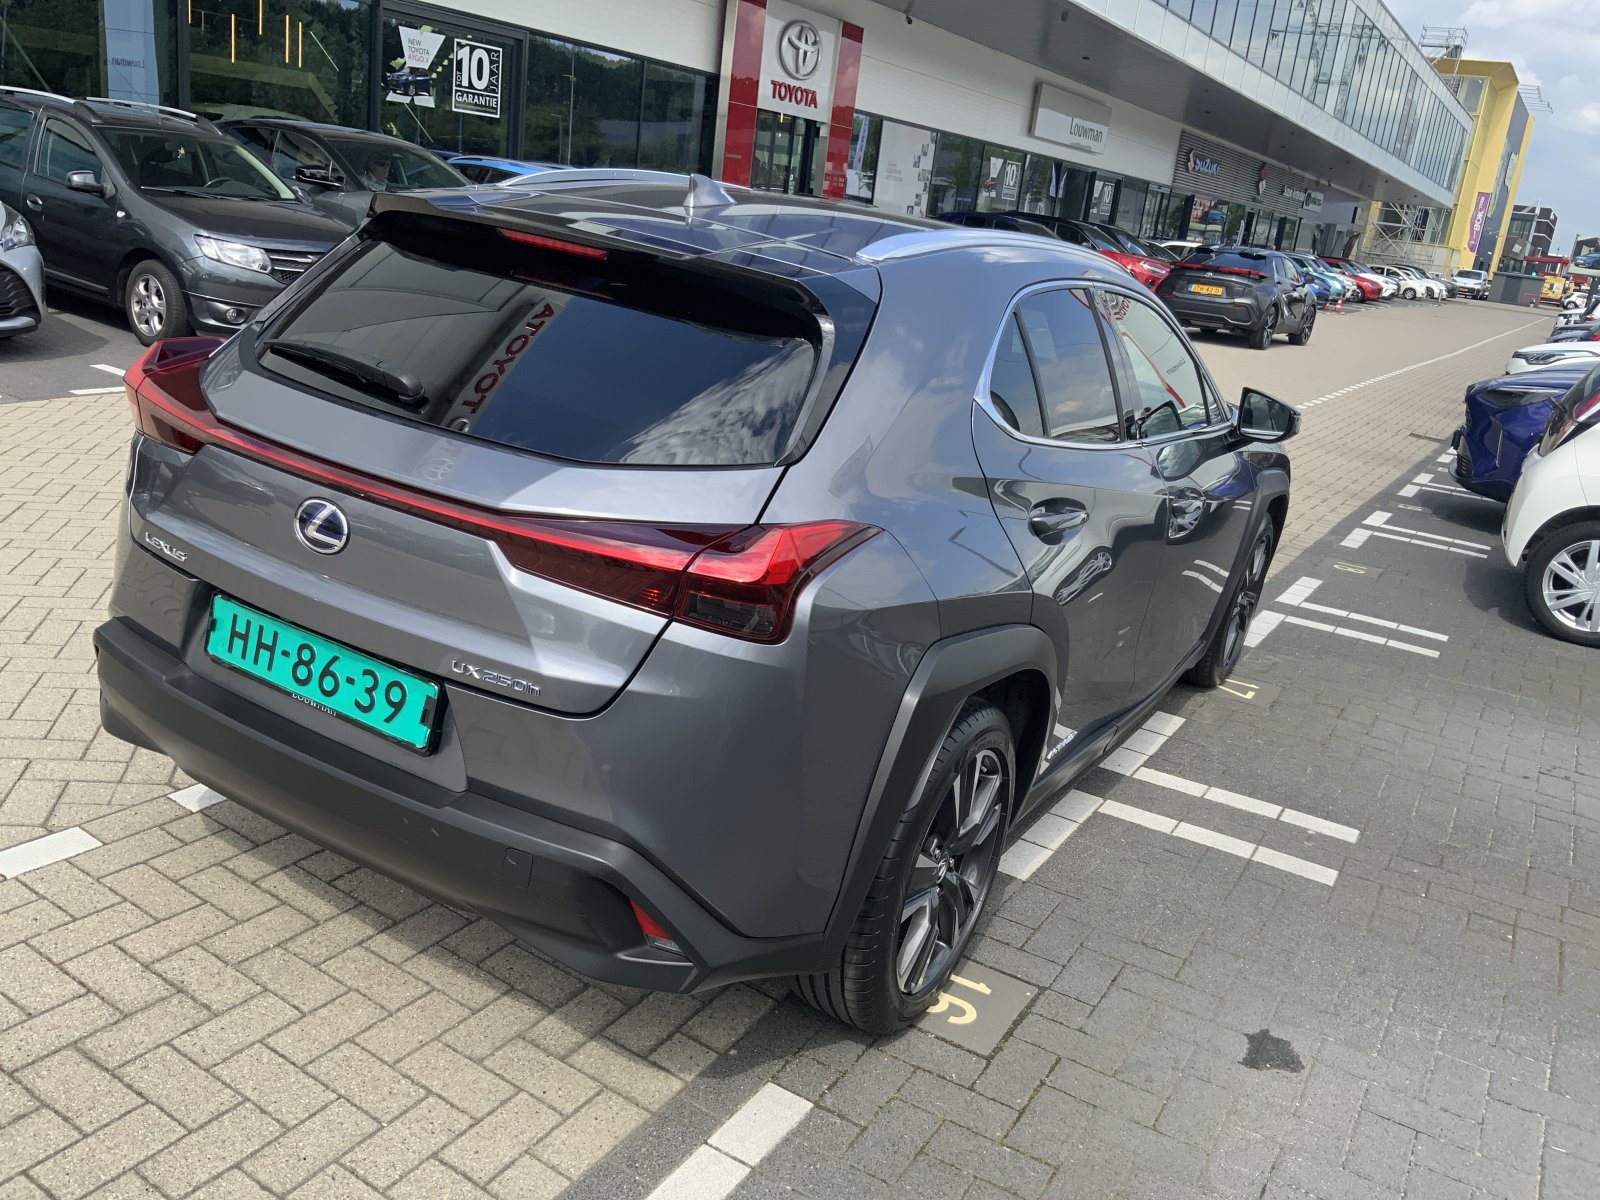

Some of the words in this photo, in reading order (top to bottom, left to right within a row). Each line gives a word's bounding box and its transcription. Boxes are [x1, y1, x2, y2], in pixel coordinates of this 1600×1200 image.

[408, 38, 421, 46] NEW
[408, 46, 430, 56] TOYOTA
[457, 45, 490, 90] 10
[489, 51, 499, 92] JAAR
[455, 92, 498, 108] GARANTIE
[771, 80, 817, 109] TOYOTA
[1069, 117, 1103, 143] Louwman
[1005, 163, 1017, 187] 10
[145, 531, 188, 562] LEXUS
[227, 613, 408, 724] HH-86-39
